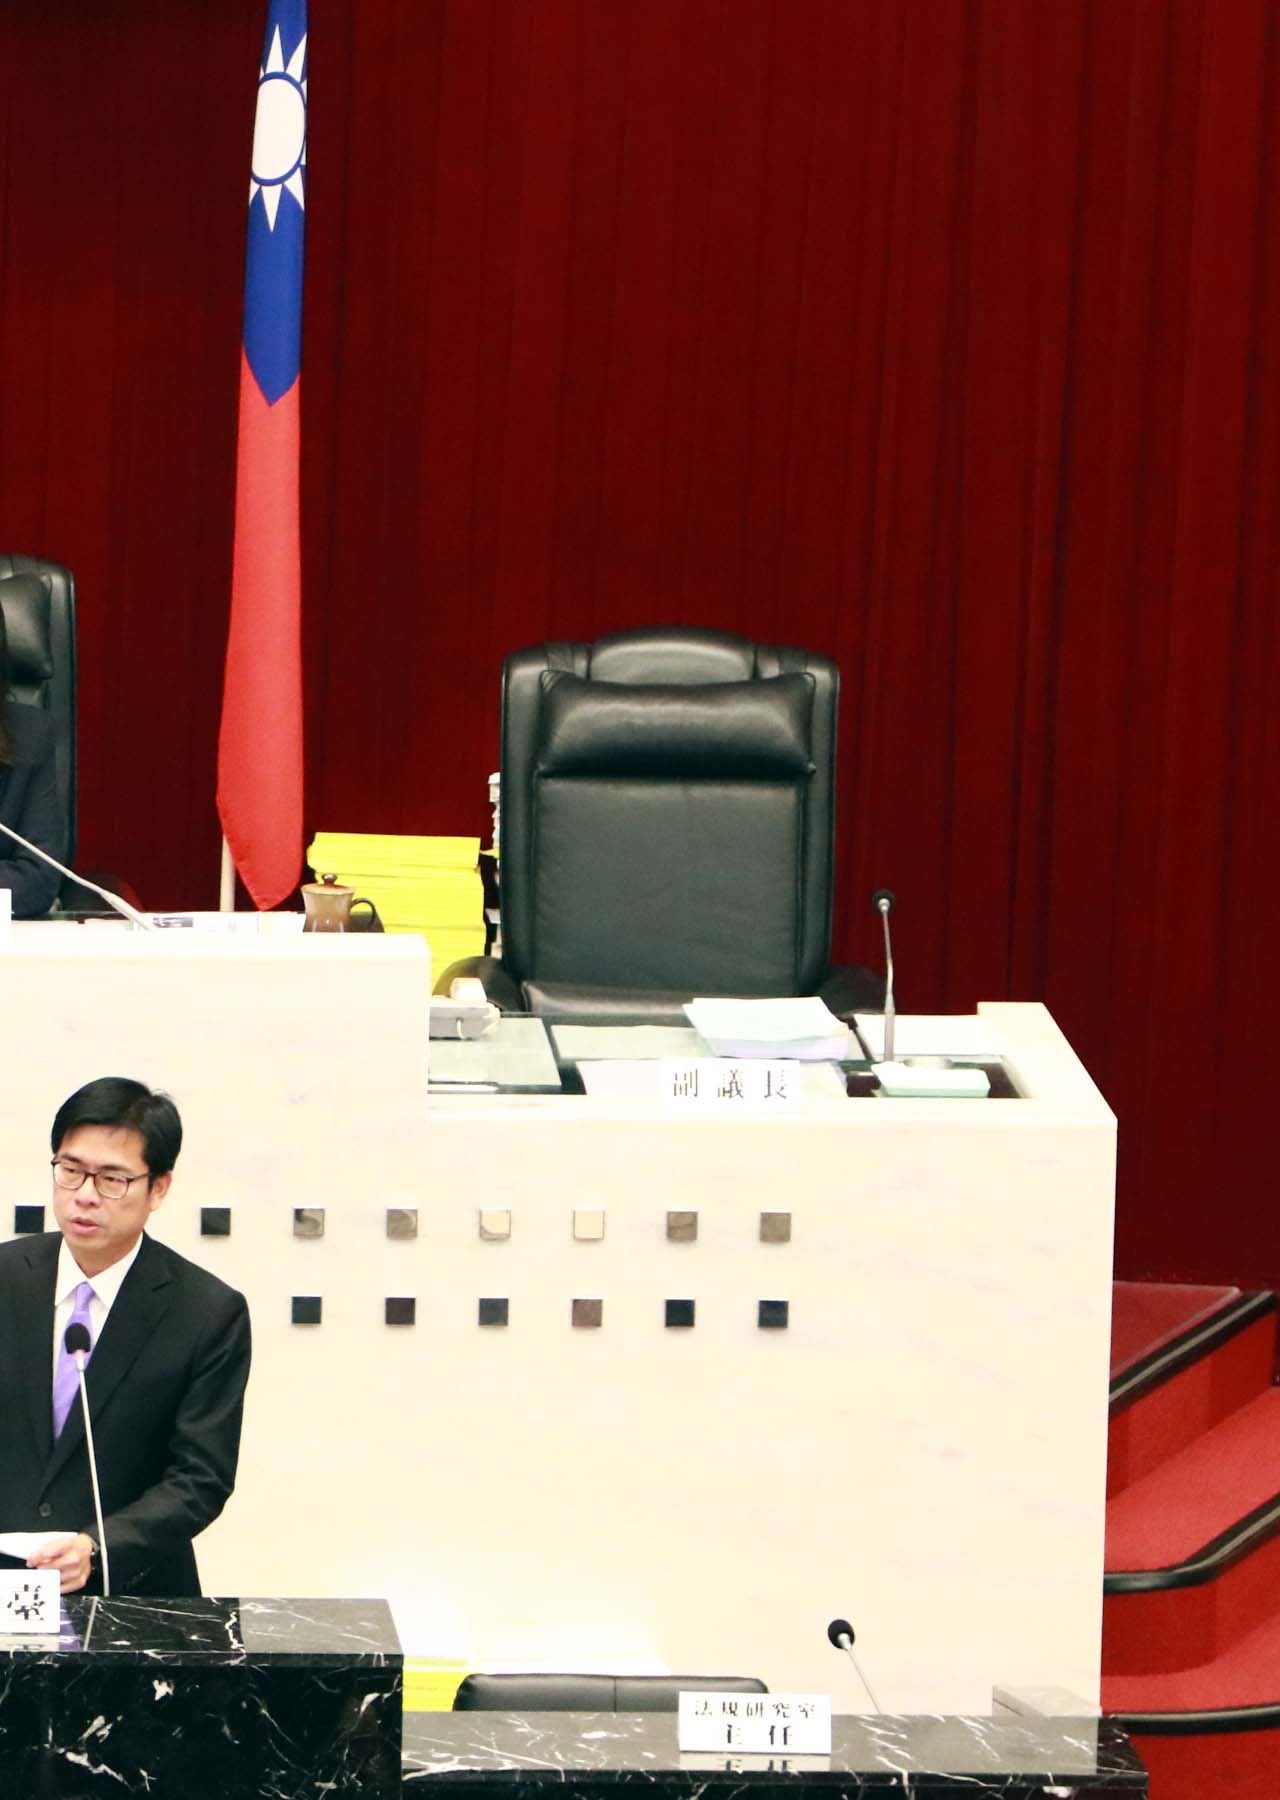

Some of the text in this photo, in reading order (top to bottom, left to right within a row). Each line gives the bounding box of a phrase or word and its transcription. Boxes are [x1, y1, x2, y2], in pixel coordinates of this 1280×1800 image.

[671, 1067, 788, 1100] 副議長
[721, 1723, 794, 1746] 主任
